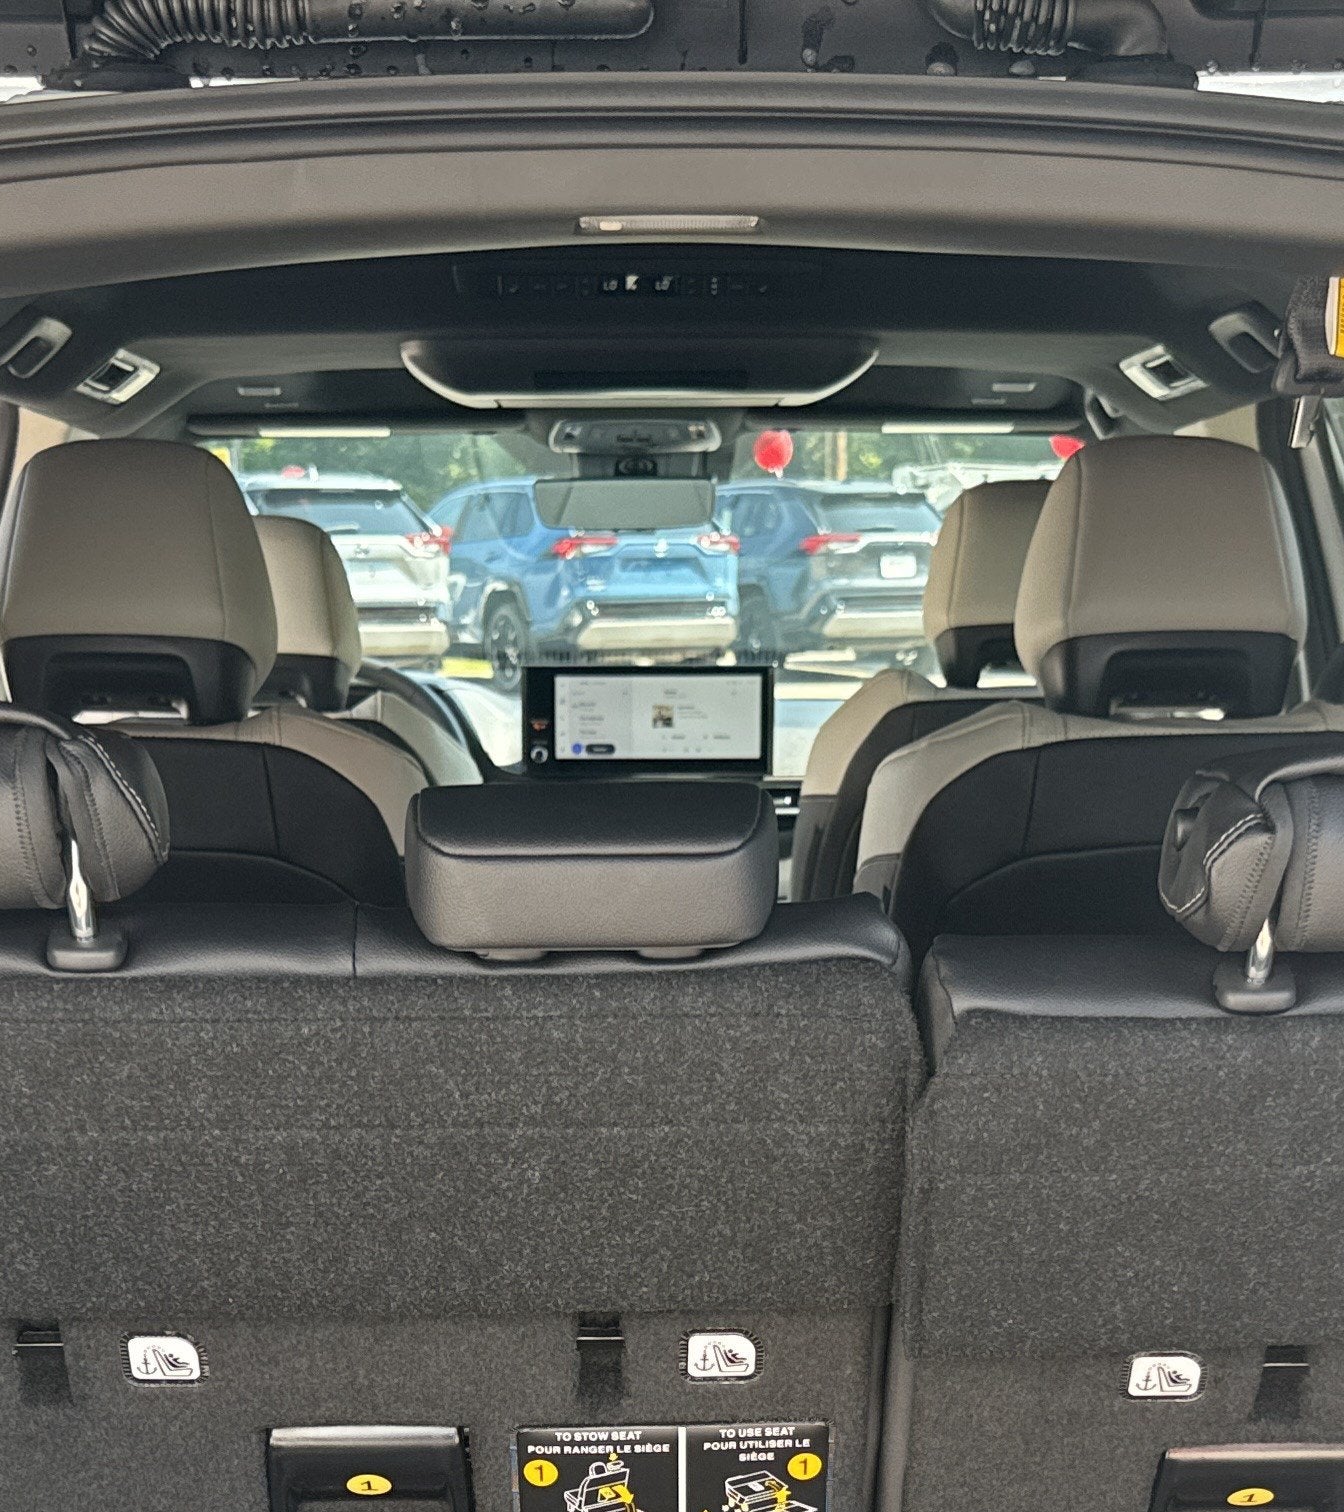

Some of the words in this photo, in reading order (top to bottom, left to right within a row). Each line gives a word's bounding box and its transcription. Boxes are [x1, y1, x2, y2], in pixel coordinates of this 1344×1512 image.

[555, 1431, 572, 1442] TO
[574, 1431, 608, 1442] STOW
[611, 1430, 642, 1441] SEAT
[719, 1429, 736, 1438] TO
[738, 1427, 763, 1438] USE
[764, 1426, 796, 1437] SEAT
[527, 1445, 561, 1454] POUR
[563, 1444, 614, 1454] RANGER
[616, 1444, 632, 1453] LE
[634, 1442, 670, 1453] SIÈGE
[703, 1441, 737, 1451] POUR
[739, 1439, 793, 1450] UTILISER
[795, 1438, 811, 1448] LE
[739, 1451, 775, 1462] SIÈGE
